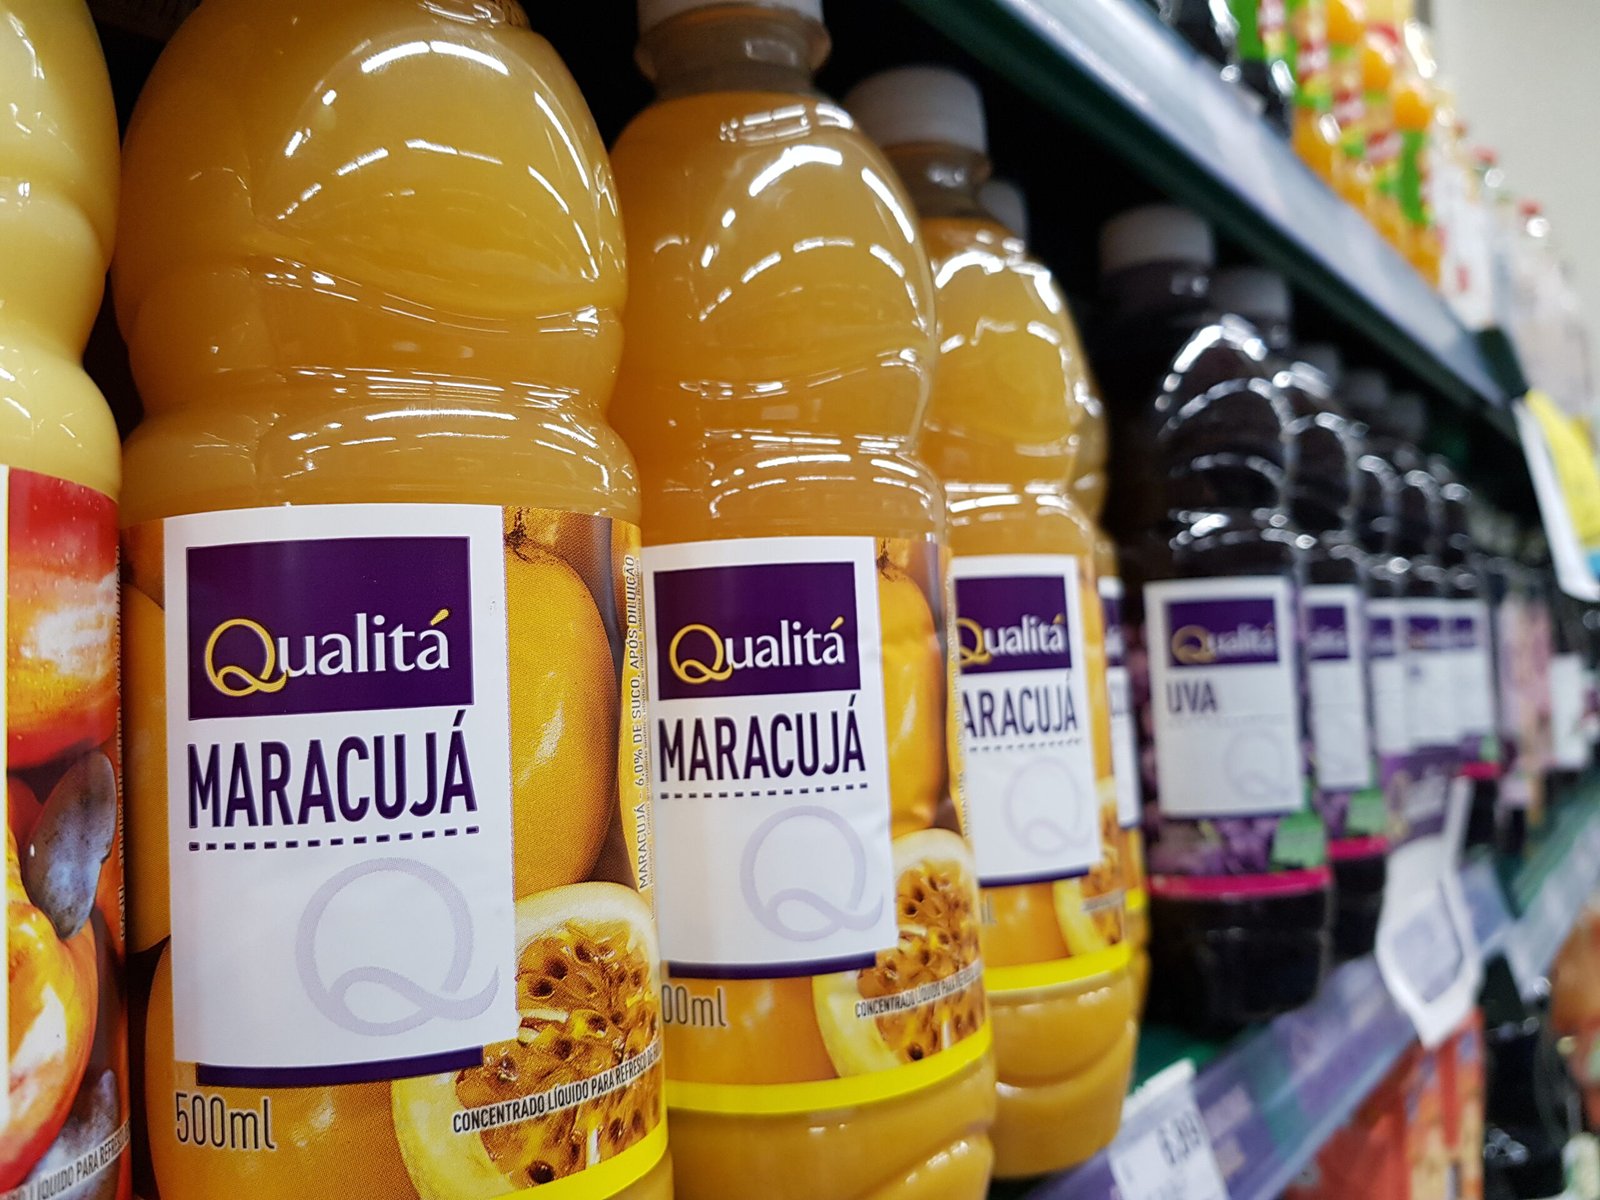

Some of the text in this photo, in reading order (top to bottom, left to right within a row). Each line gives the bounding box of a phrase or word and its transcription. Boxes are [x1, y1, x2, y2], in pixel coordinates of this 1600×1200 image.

[624, 556, 637, 624] DILUIÇÃO
[204, 608, 450, 697] Qualitá
[625, 629, 639, 668] APÓS
[669, 615, 846, 684] Qualitá
[956, 612, 1067, 669] Qualitá
[963, 669, 1079, 738] ARACUJÁ
[1165, 679, 1219, 715] UVA
[632, 723, 643, 744] DE
[658, 693, 867, 782] MARACUJÁ
[187, 709, 478, 829] MARACUJÁ
[633, 803, 648, 889] MARACUJÁ
[740, 804, 884, 942] Q
[298, 857, 500, 1037] Q
[661, 984, 727, 1028] 00ml
[175, 1091, 276, 1150] 500ml
[453, 1094, 545, 1133] CONCENTRADO
[549, 1080, 589, 1111] LÍQUIDO
[591, 1070, 615, 1096] PARA
[615, 1051, 647, 1085] REFRESCO
[76, 1150, 99, 1182] PARA
